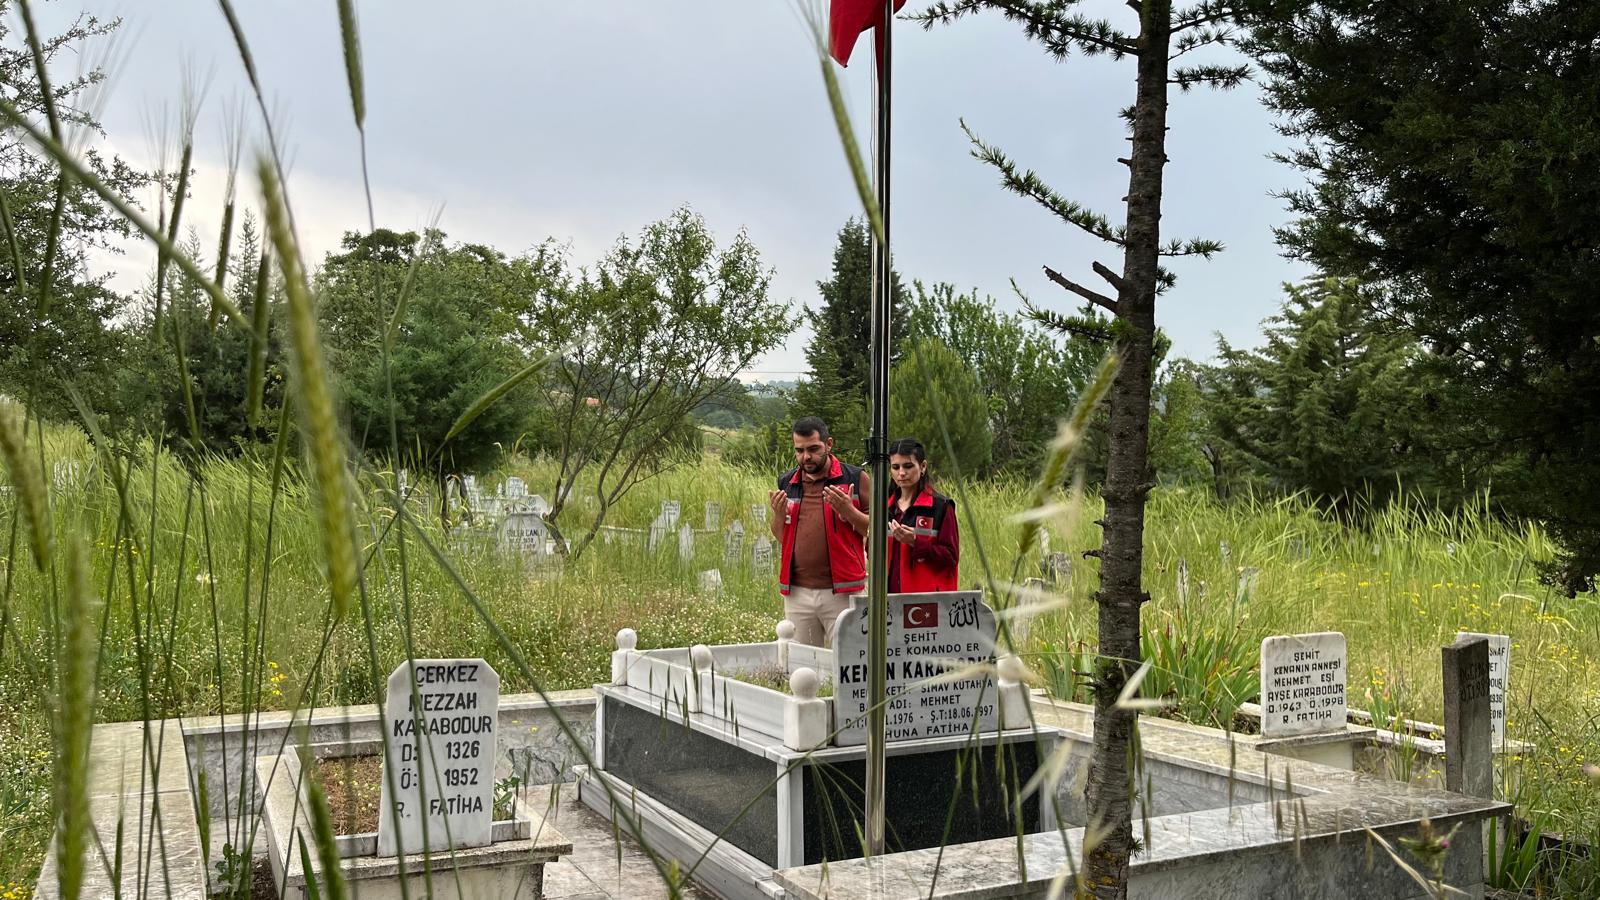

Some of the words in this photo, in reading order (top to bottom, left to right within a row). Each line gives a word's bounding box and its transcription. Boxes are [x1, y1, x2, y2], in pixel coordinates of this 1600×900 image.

[904, 632, 938, 645] ŞEHİT
[859, 647, 901, 659] PDE
[906, 643, 962, 655] KOMANDO
[966, 642, 980, 652] ER
[1294, 648, 1321, 662] ŞEHİT
[840, 661, 896, 684] KENN
[1273, 664, 1310, 675] KENANIN
[1311, 658, 1341, 671] ANNESİ
[415, 665, 479, 687] ÇERKEZ
[1274, 675, 1311, 688] MEHMET
[1320, 671, 1335, 683] EŞİ
[852, 682, 912, 699] MEKETİ:
[1267, 690, 1291, 702] AYŞE
[1293, 683, 1344, 699] KARABODUR
[889, 700, 912, 711] ADI:
[920, 695, 961, 707] MEHMET
[1309, 697, 1344, 708] Ö.1998
[930, 705, 994, 722] Ş.T:18.06.997
[1282, 715, 1294, 724] R.
[1297, 708, 1332, 722] FATİHA
[393, 716, 492, 737] KARABODUR
[885, 727, 919, 739] HUNA
[926, 722, 969, 736] FATİHA
[446, 740, 481, 760] 1326
[400, 768, 418, 789] Ö:
[444, 768, 479, 787] 1952
[430, 794, 483, 816] FATİHA
